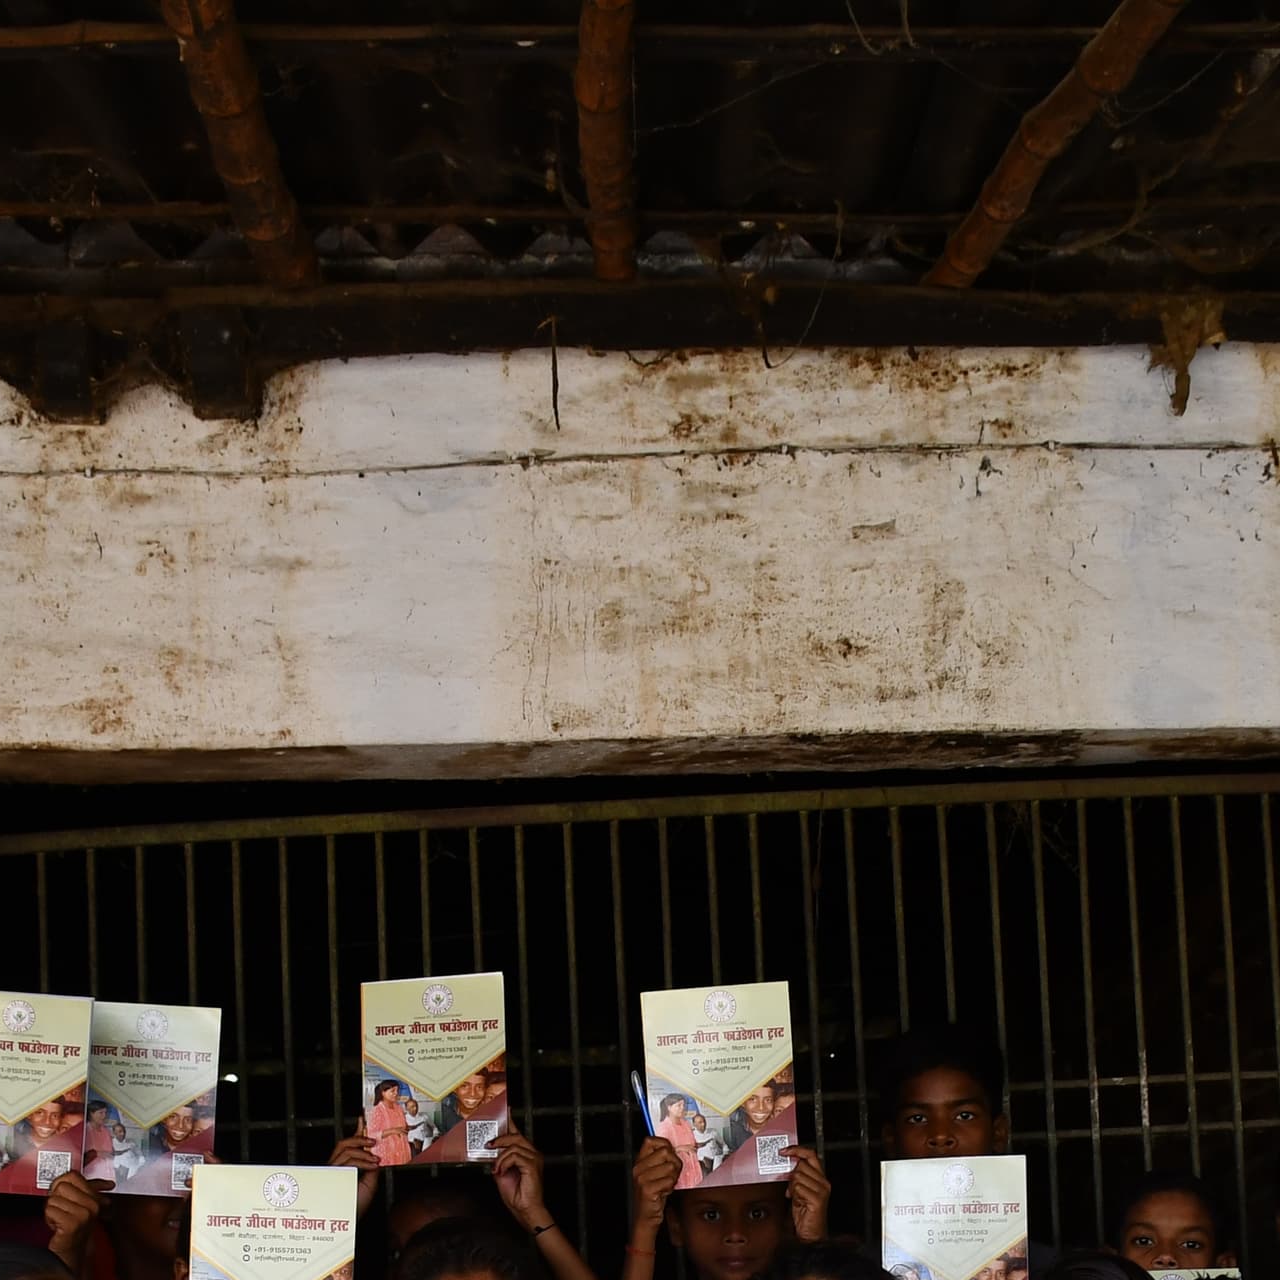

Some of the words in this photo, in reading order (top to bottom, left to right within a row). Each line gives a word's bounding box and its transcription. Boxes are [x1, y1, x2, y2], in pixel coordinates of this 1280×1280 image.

[375, 1024, 406, 1037] आनन्द
[407, 1021, 436, 1035] जीवन
[438, 1018, 479, 1033] फाउंडेशन
[481, 1019, 499, 1033] ट्रस्ट
[656, 1033, 689, 1047] आनन्द
[690, 1029, 720, 1044] जीवन
[722, 1026, 764, 1042] फाउंडेशन
[766, 1026, 785, 1041] ट्रस्ट
[17, 1039, 60, 1056] फाउंडेशन
[62, 1045, 81, 1058] ट्रस्ट
[120, 1044, 149, 1059] जीवन
[151, 1046, 192, 1062] फाउंडेशन
[194, 1051, 213, 1064] ट्रस्ट
[206, 1214, 242, 1228] आनन्द
[245, 1213, 277, 1229] जीवन
[280, 1214, 327, 1231] फाउंडेशन
[329, 1219, 350, 1234] ट्रस्ट
